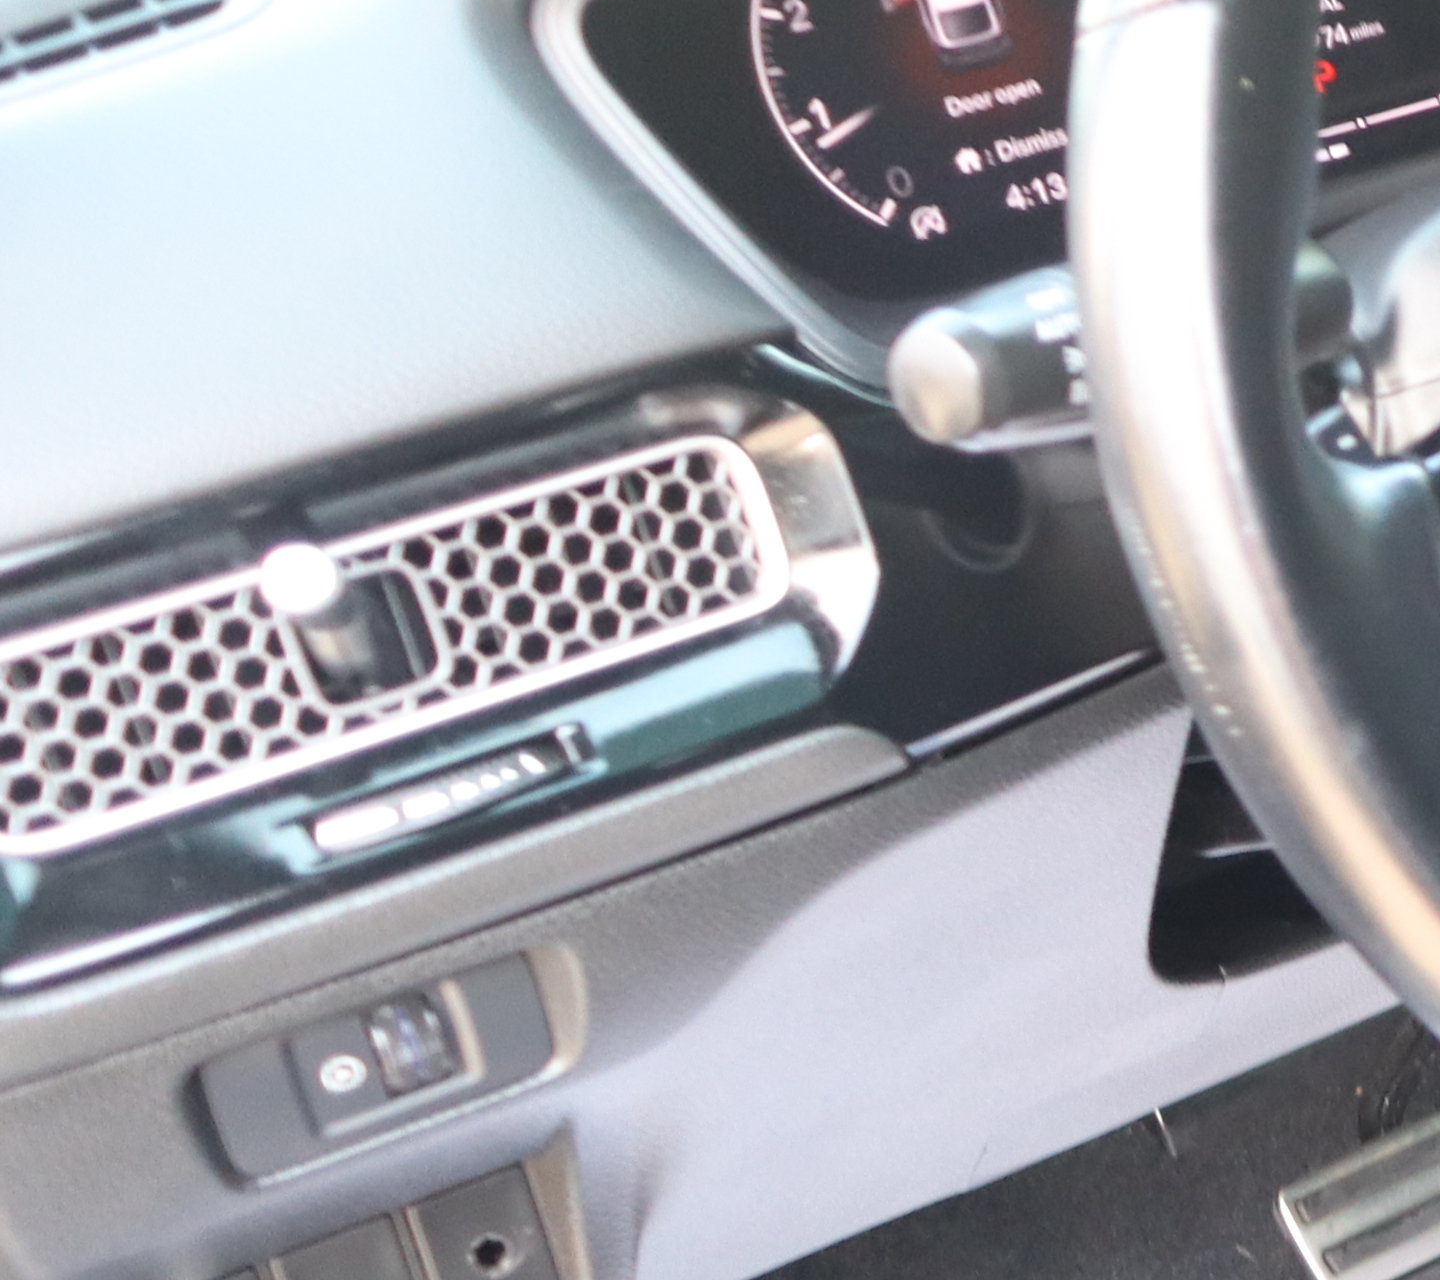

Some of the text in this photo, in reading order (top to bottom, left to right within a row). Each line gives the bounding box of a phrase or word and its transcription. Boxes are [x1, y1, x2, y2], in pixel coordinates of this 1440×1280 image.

[808, 96, 831, 132] 1
[943, 77, 1044, 119] Door open
[885, 165, 915, 198] 0
[1006, 171, 1068, 211] 4:13
